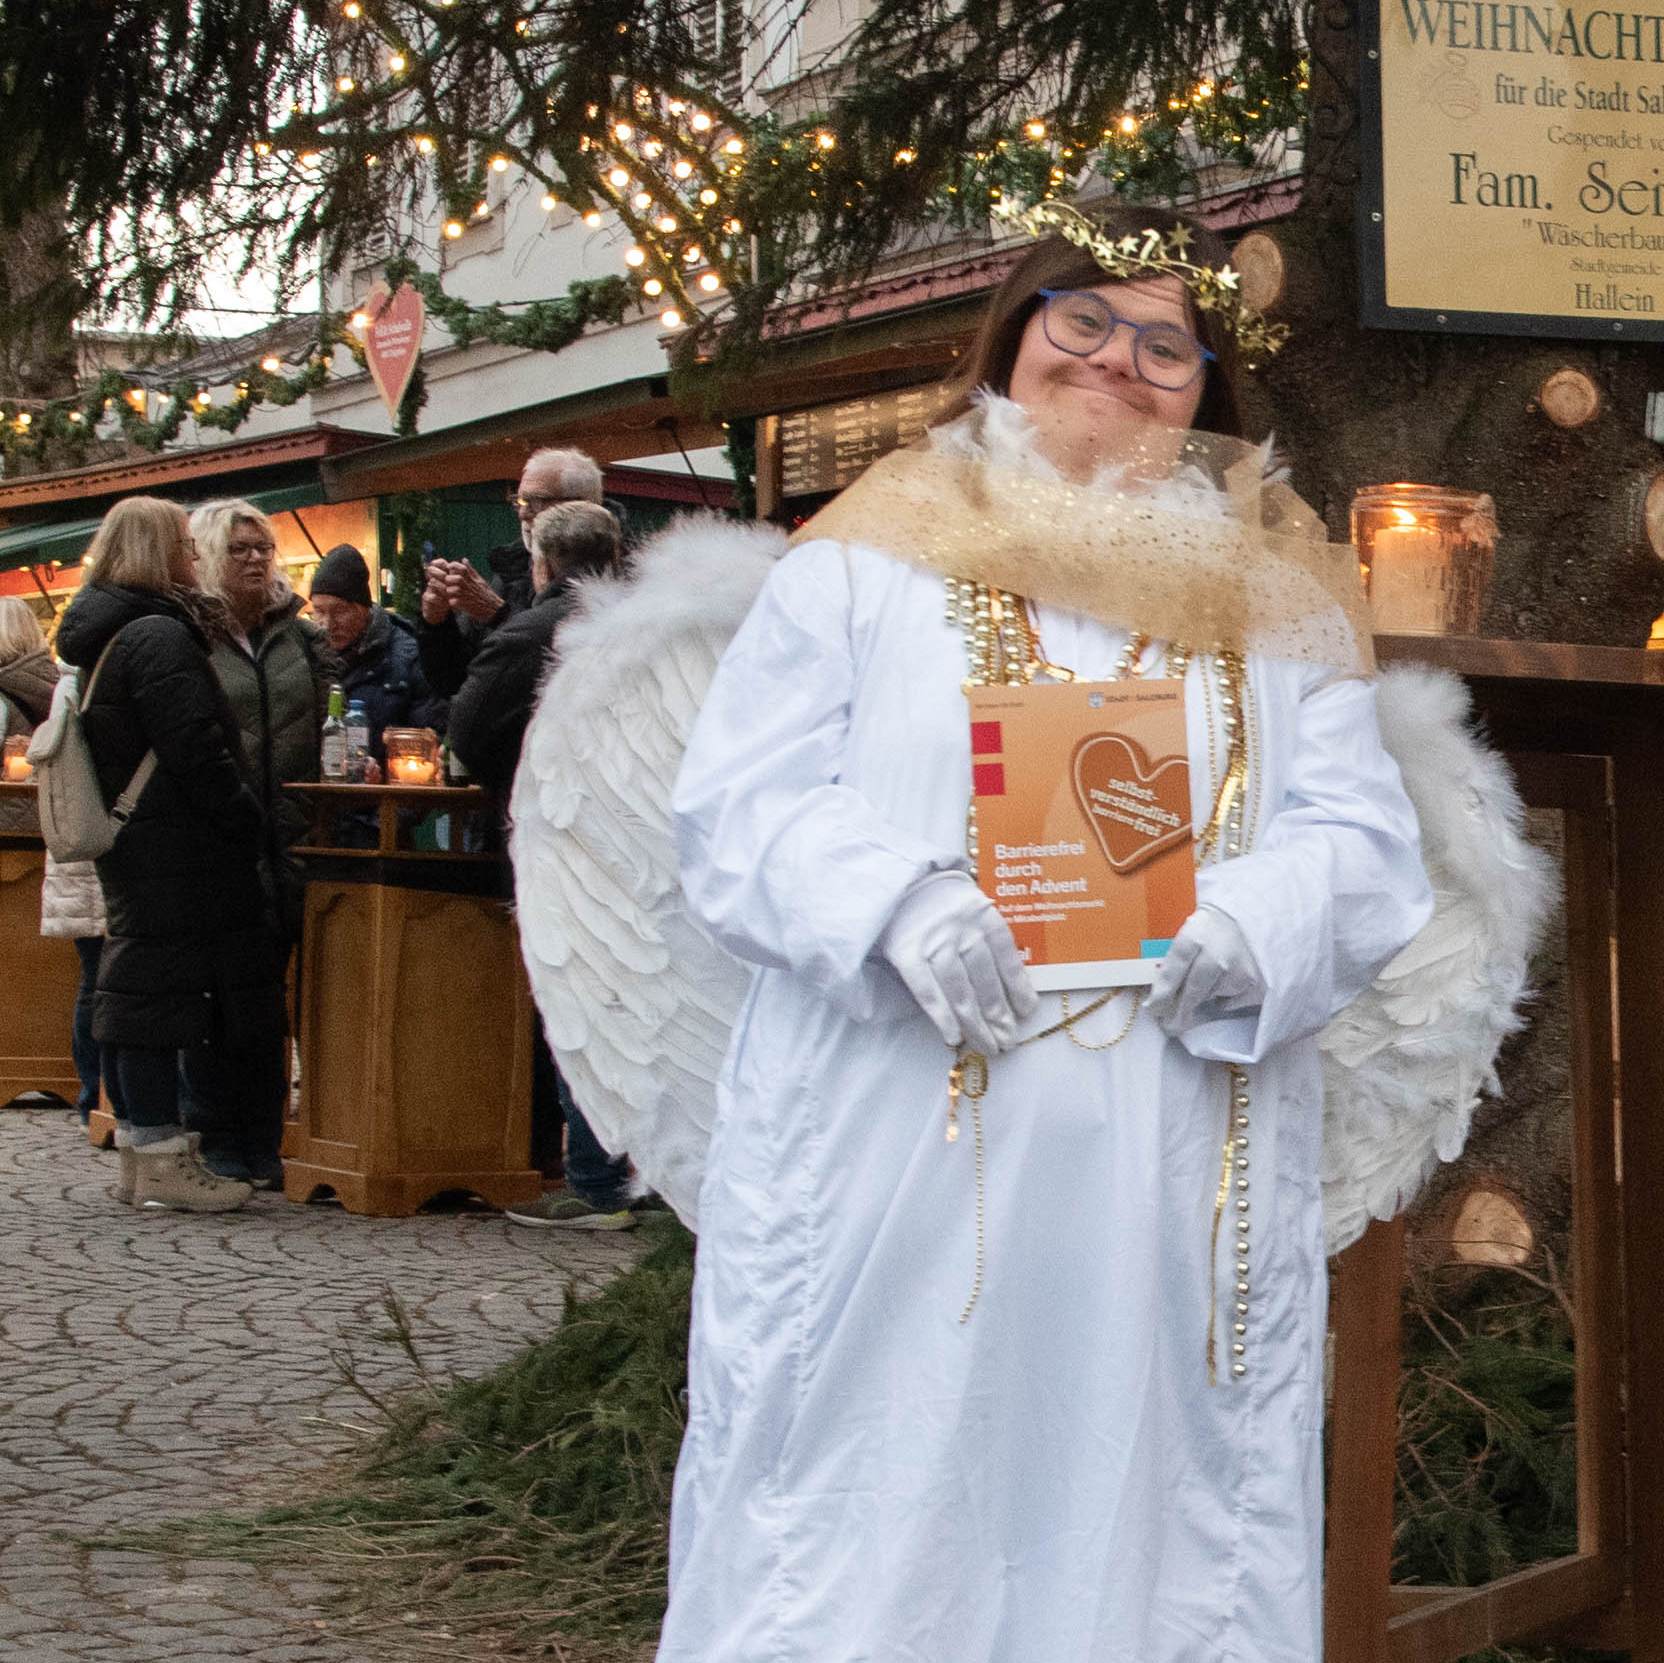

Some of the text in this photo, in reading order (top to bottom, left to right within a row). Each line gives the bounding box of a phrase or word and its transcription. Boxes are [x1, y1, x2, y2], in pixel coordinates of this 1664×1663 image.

[1494, 73, 1527, 106] für
[1534, 76, 1567, 108] die
[1574, 81, 1631, 113] Stadt
[1547, 125, 1643, 154] Gespendet
[1448, 150, 1554, 211] Fam.
[1574, 282, 1656, 313] Hallein
[994, 839, 1087, 860] Barrierefrei
[994, 861, 1044, 878] durch
[995, 876, 1088, 897] den Advent
